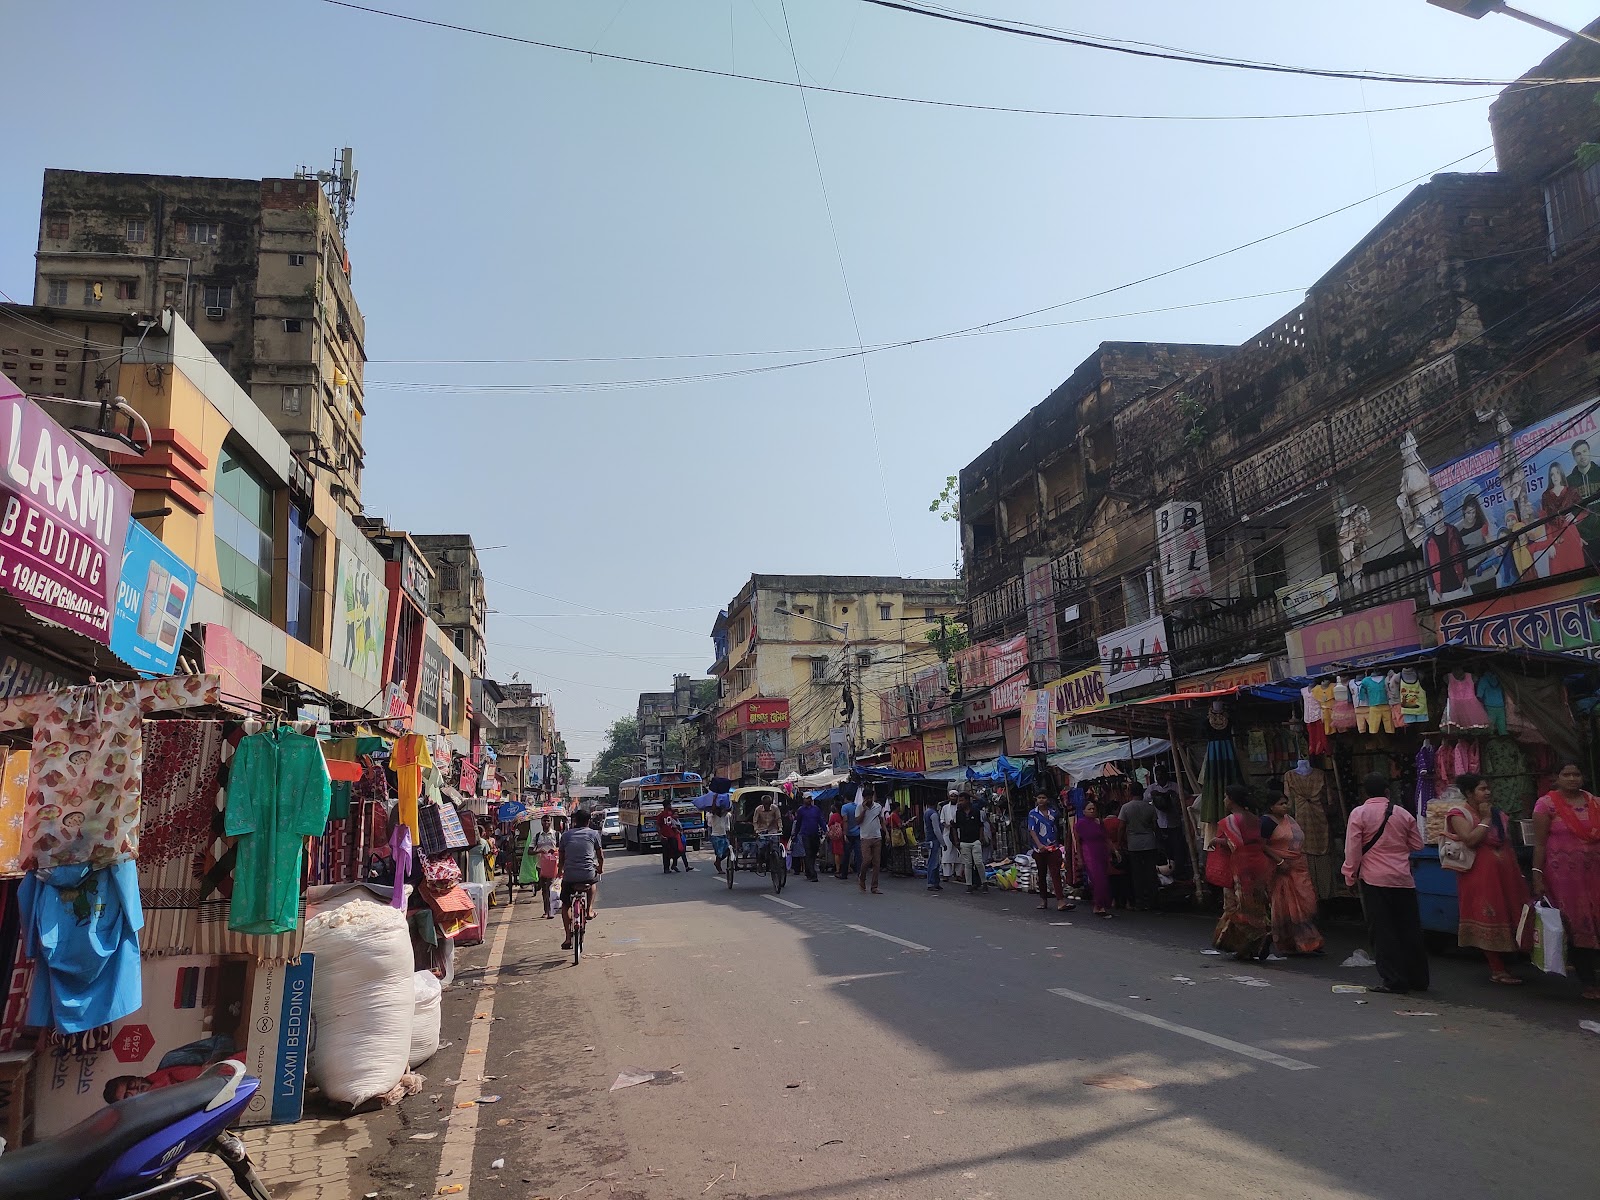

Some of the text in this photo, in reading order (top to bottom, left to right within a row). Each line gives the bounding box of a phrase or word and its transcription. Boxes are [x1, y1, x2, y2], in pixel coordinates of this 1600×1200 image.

[8, 402, 114, 546] LAXMI
[1486, 462, 1537, 492] WOEN
[1, 495, 103, 586] BEDDING
[1111, 634, 1166, 676] BALA
[1056, 671, 1104, 715] UMANG
[663, 816, 672, 825] 10
[263, 995, 271, 1015] LONG
[282, 979, 305, 1097] LAXMI BEDDING
